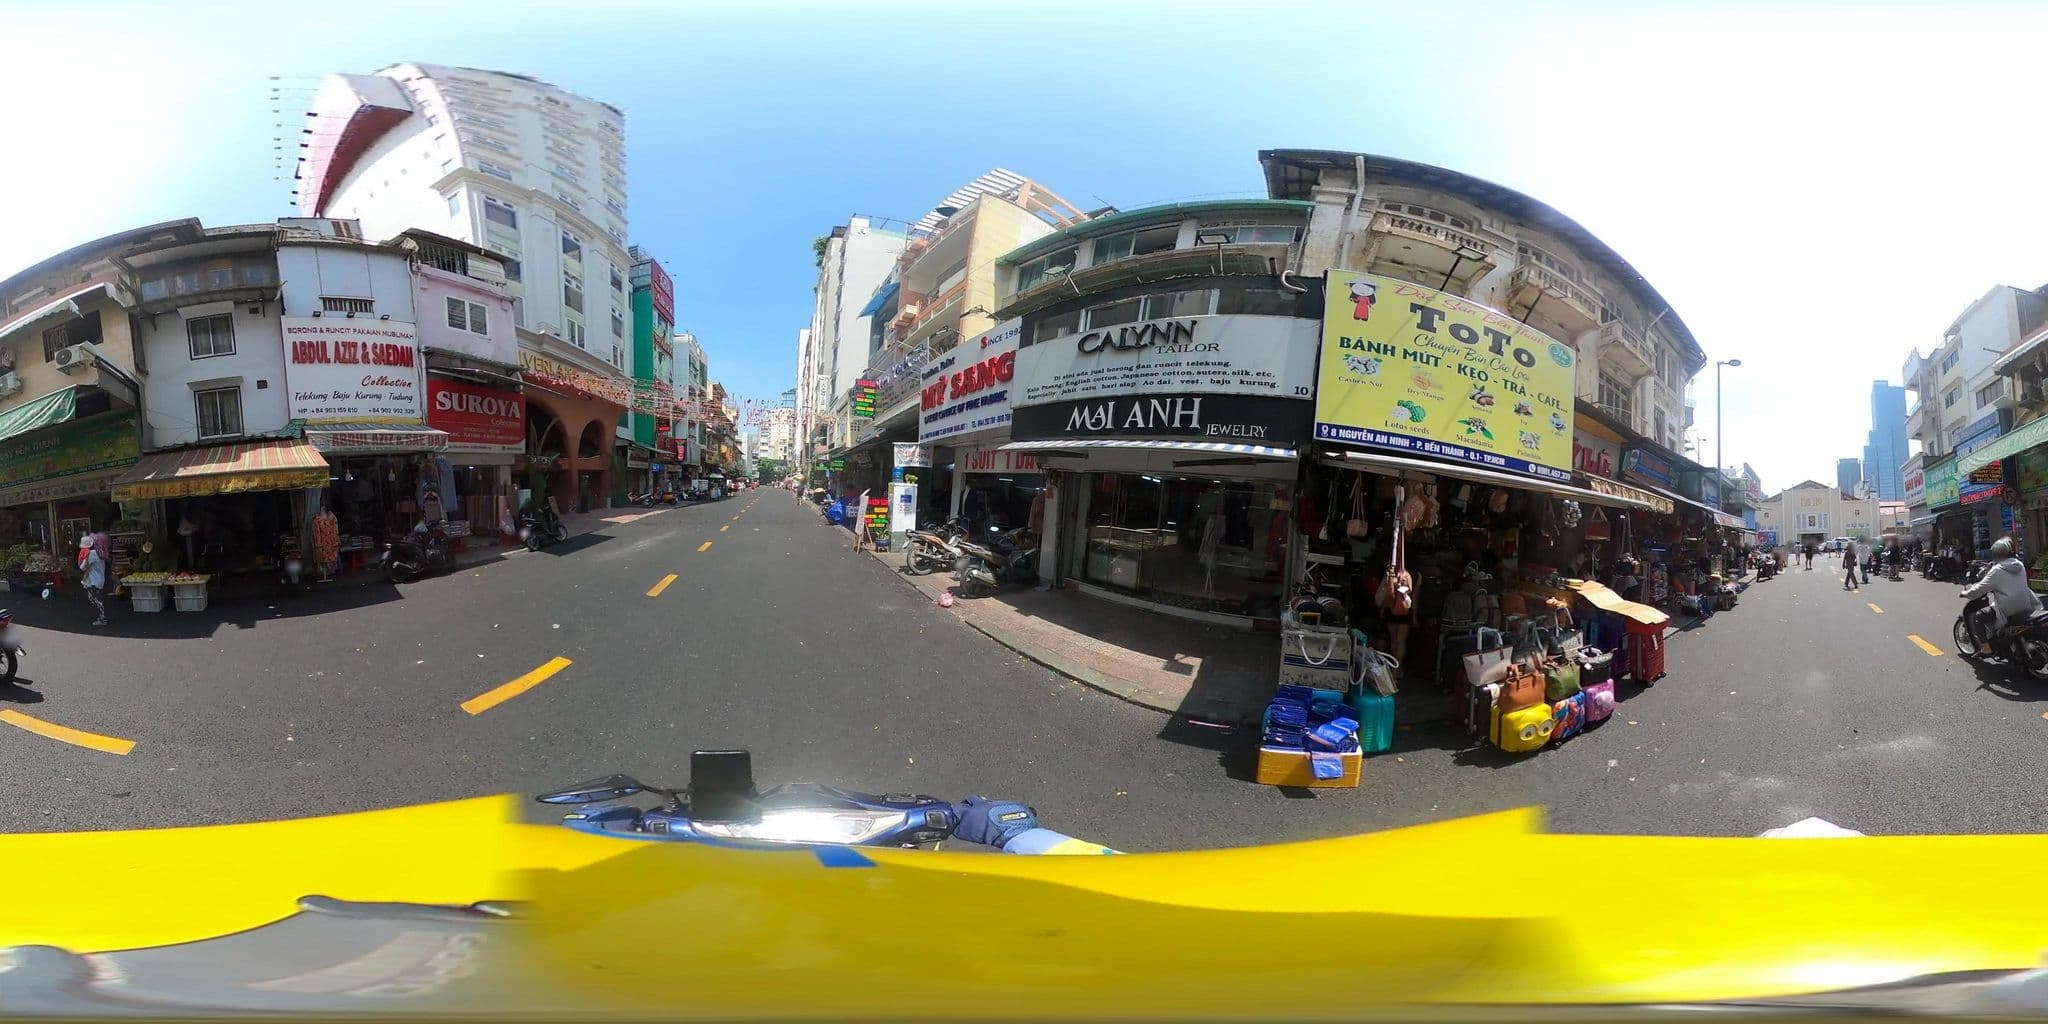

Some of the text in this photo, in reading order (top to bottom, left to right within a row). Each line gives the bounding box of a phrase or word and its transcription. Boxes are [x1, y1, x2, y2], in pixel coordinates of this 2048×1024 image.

[287, 327, 317, 335] BORONG
[325, 327, 351, 335] RUNCIT
[352, 327, 381, 337] PAKAIAN
[1077, 319, 1198, 354] CALYNN
[292, 340, 414, 368] ABDUL AZIZ & SAEDAH
[1154, 343, 1220, 354] TAILOR
[1339, 336, 1396, 358] BÁNH
[1456, 362, 1489, 383] KẸO
[1106, 364, 1134, 373] borong
[1135, 362, 1152, 370] dan
[361, 374, 413, 388] Collection
[950, 350, 1017, 401] SANG
[1065, 377, 1091, 387] English
[1120, 371, 1160, 380] Japanese
[1210, 378, 1231, 386] baju
[294, 390, 414, 404] Telekung Baju Kurung Tudung
[1294, 386, 1309, 396] 10
[435, 390, 521, 418] SUROYA
[1065, 397, 1203, 431] MAI ANH
[1206, 423, 1267, 438] JEWELRY
[1384, 420, 1430, 435] Lotus seeds
[1330, 428, 1337, 437] 8
[1375, 435, 1388, 445] AN
[1389, 436, 1410, 448] NINH
[971, 450, 997, 469] SUIT
[1004, 451, 1011, 469] 1
